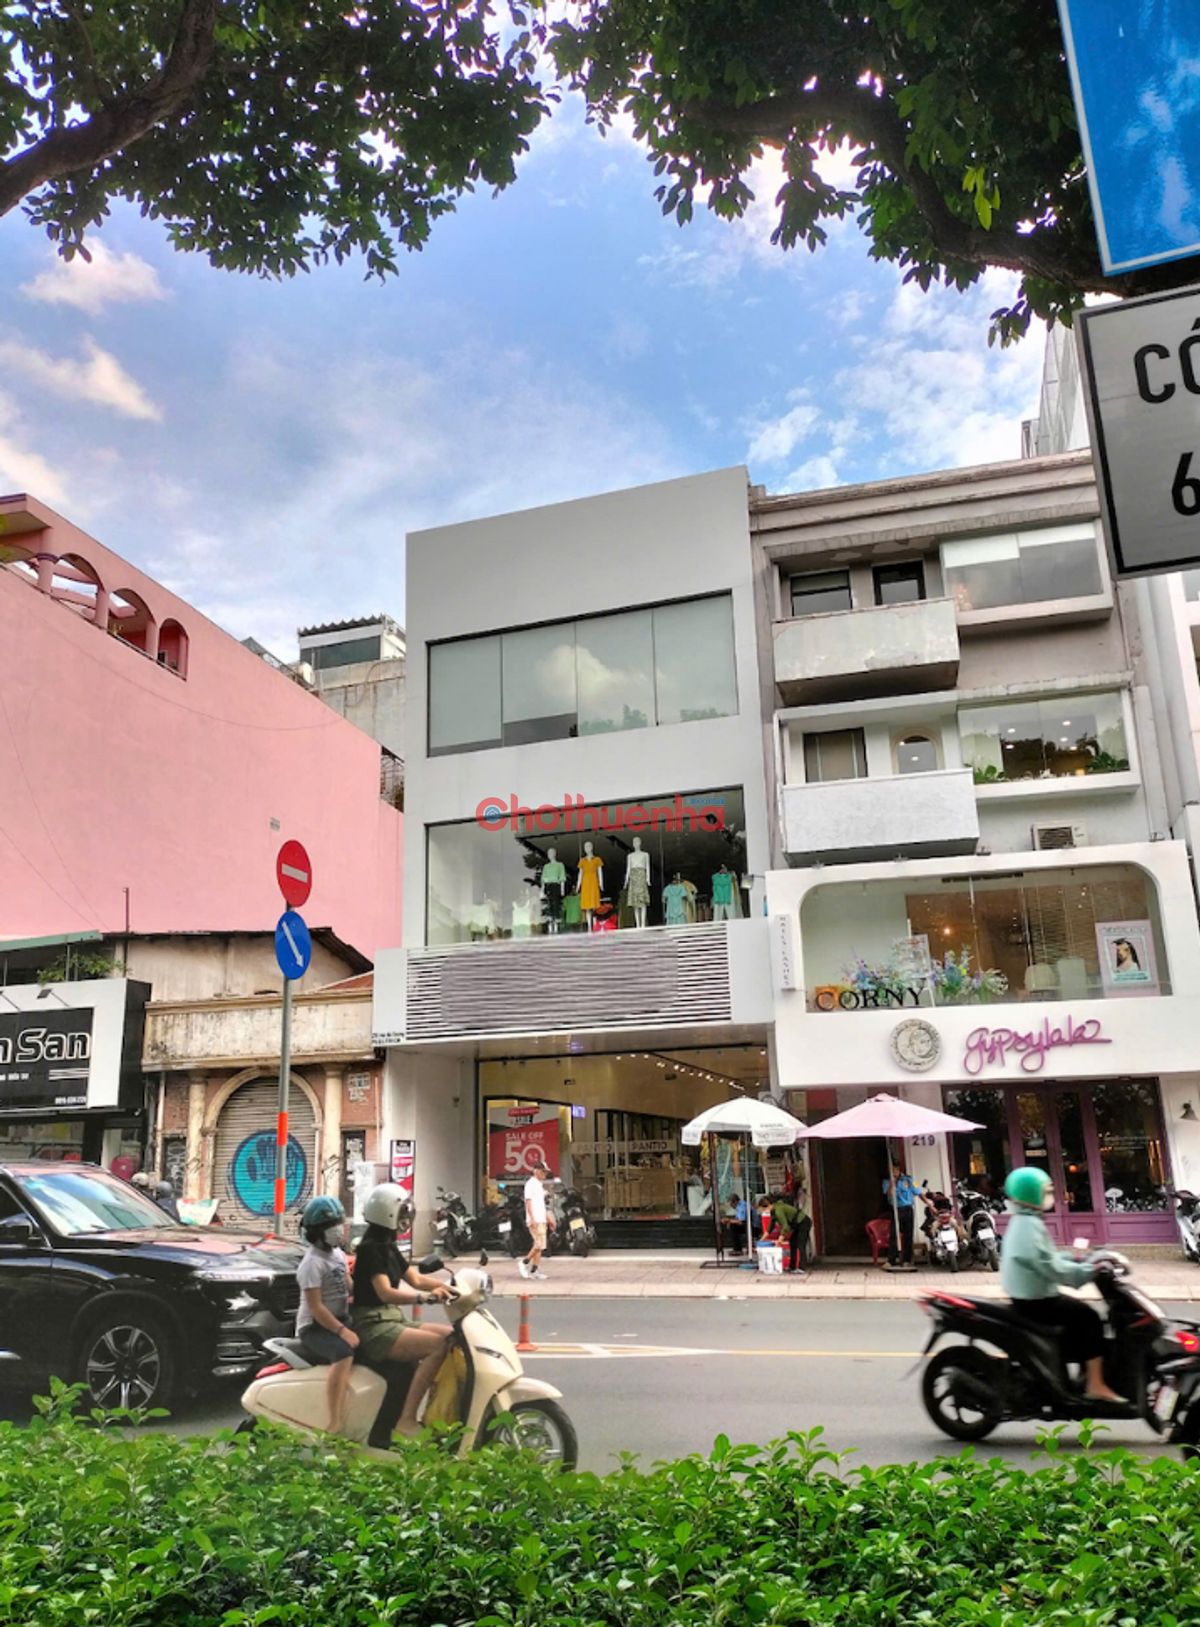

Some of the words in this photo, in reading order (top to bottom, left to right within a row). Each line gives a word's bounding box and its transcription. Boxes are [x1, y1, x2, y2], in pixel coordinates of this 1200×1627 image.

[815, 977, 927, 1012] CORNY
[15, 1027, 91, 1063] San
[964, 1013, 1113, 1076] gypsylala
[505, 1132, 526, 1141] SALE
[527, 1131, 544, 1140] OFF
[911, 1134, 936, 1147] 219
